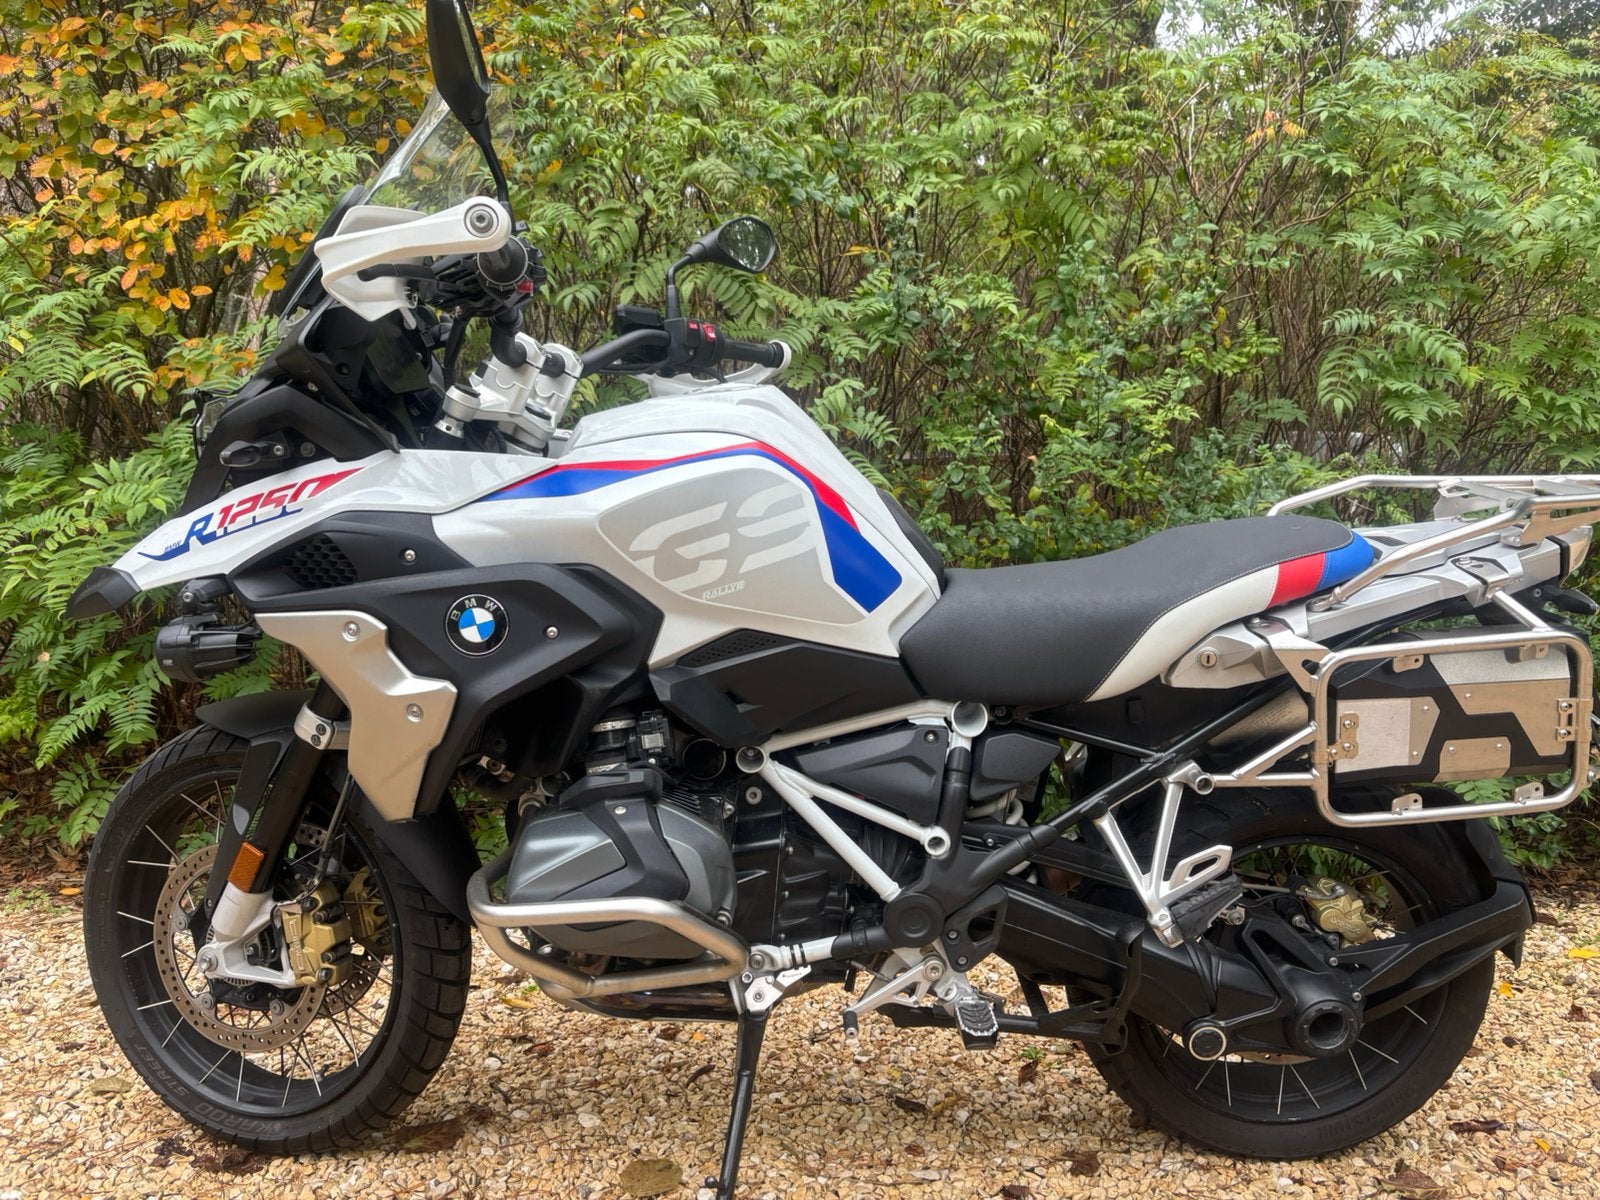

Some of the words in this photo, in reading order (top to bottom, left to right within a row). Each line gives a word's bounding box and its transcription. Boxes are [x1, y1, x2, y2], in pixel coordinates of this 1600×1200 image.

[629, 482, 816, 592] GS
[450, 597, 498, 621] BMW
[134, 1043, 190, 1096] STREET
[194, 1102, 273, 1135] KAROO
